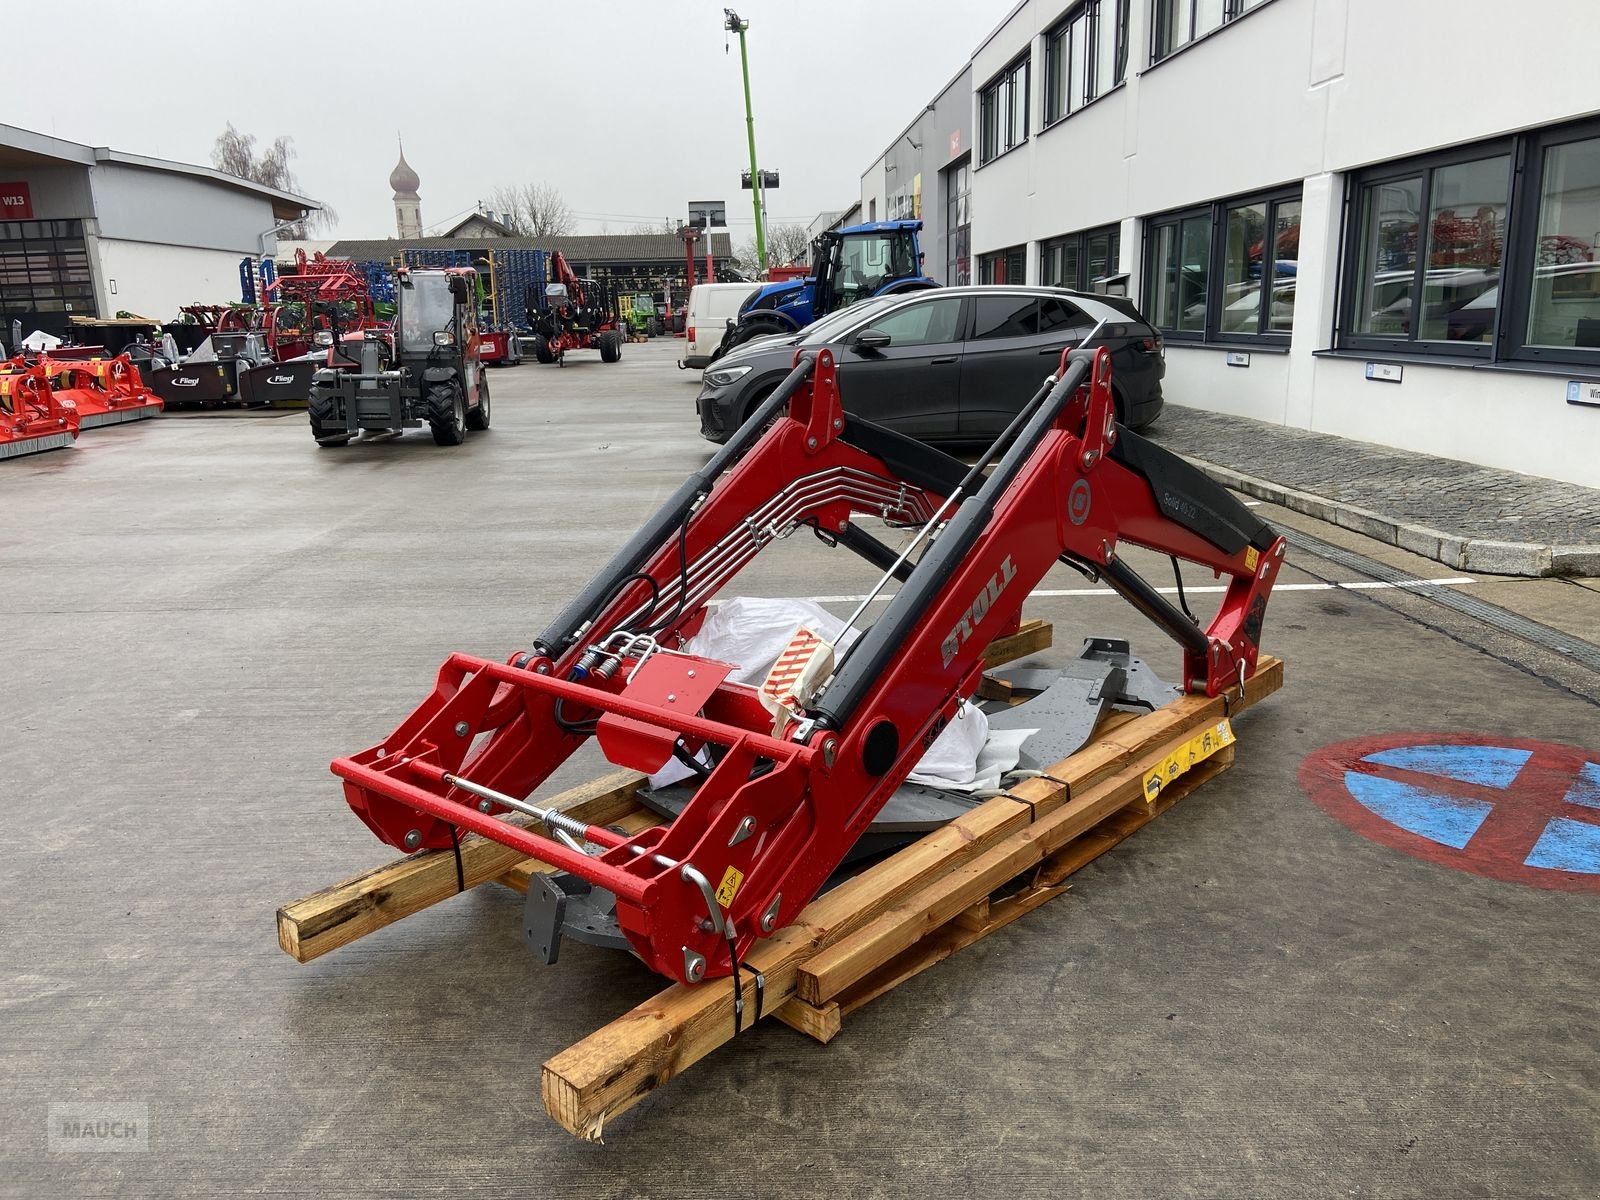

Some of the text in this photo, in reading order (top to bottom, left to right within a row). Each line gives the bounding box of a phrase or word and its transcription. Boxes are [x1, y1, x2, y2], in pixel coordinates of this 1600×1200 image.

[2, 196, 25, 206] W13
[179, 377, 199, 386] Fliegl
[275, 375, 295, 384] Fliegl
[1570, 385, 1578, 399] P
[941, 554, 1017, 670] STOLL
